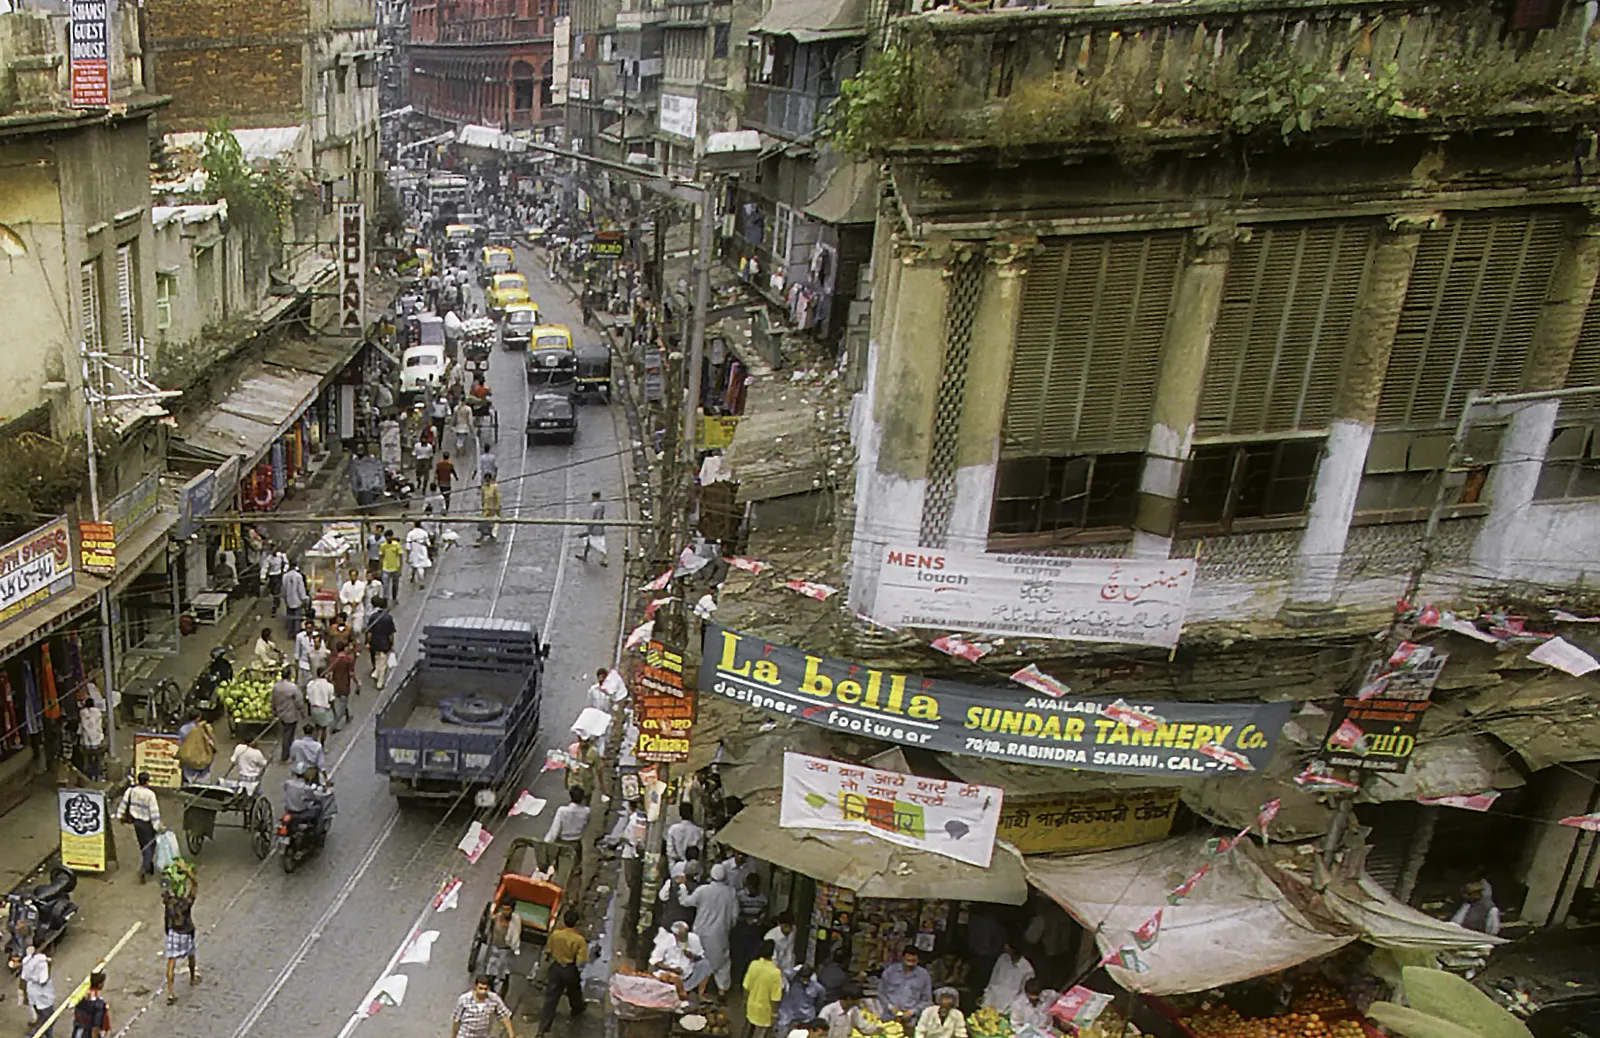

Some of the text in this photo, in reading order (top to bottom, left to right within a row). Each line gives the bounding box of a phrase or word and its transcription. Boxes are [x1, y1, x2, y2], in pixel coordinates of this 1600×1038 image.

[74, 23, 104, 39] GUEST
[887, 551, 945, 569] MENS
[918, 568, 969, 585] touch
[713, 681, 797, 714] designer
[828, 711, 932, 744] footwear
[1024, 697, 1112, 715] AVAILABL
[963, 706, 1267, 749] SUNDAR TANNERY Co.
[1006, 743, 1088, 763] RABINDRA
